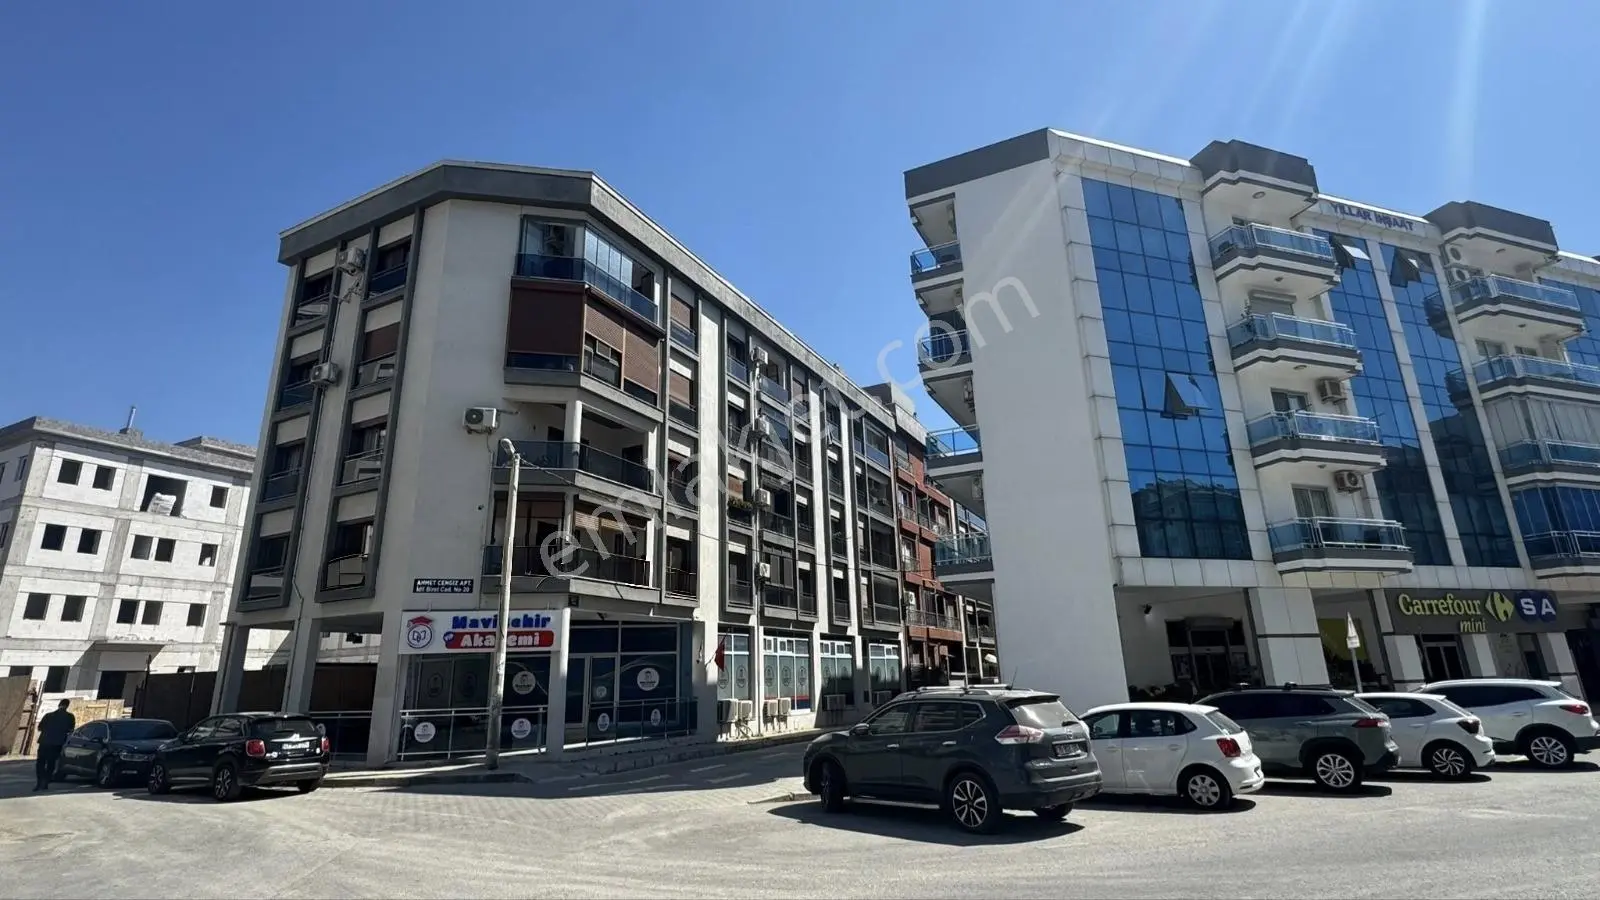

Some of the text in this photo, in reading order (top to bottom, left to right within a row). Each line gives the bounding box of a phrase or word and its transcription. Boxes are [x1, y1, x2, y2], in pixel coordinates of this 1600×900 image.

[1398, 593, 1481, 616] Carrefour
[452, 614, 551, 629] Maviehir
[1460, 618, 1487, 632] mini
[460, 633, 540, 648] Akaemi
